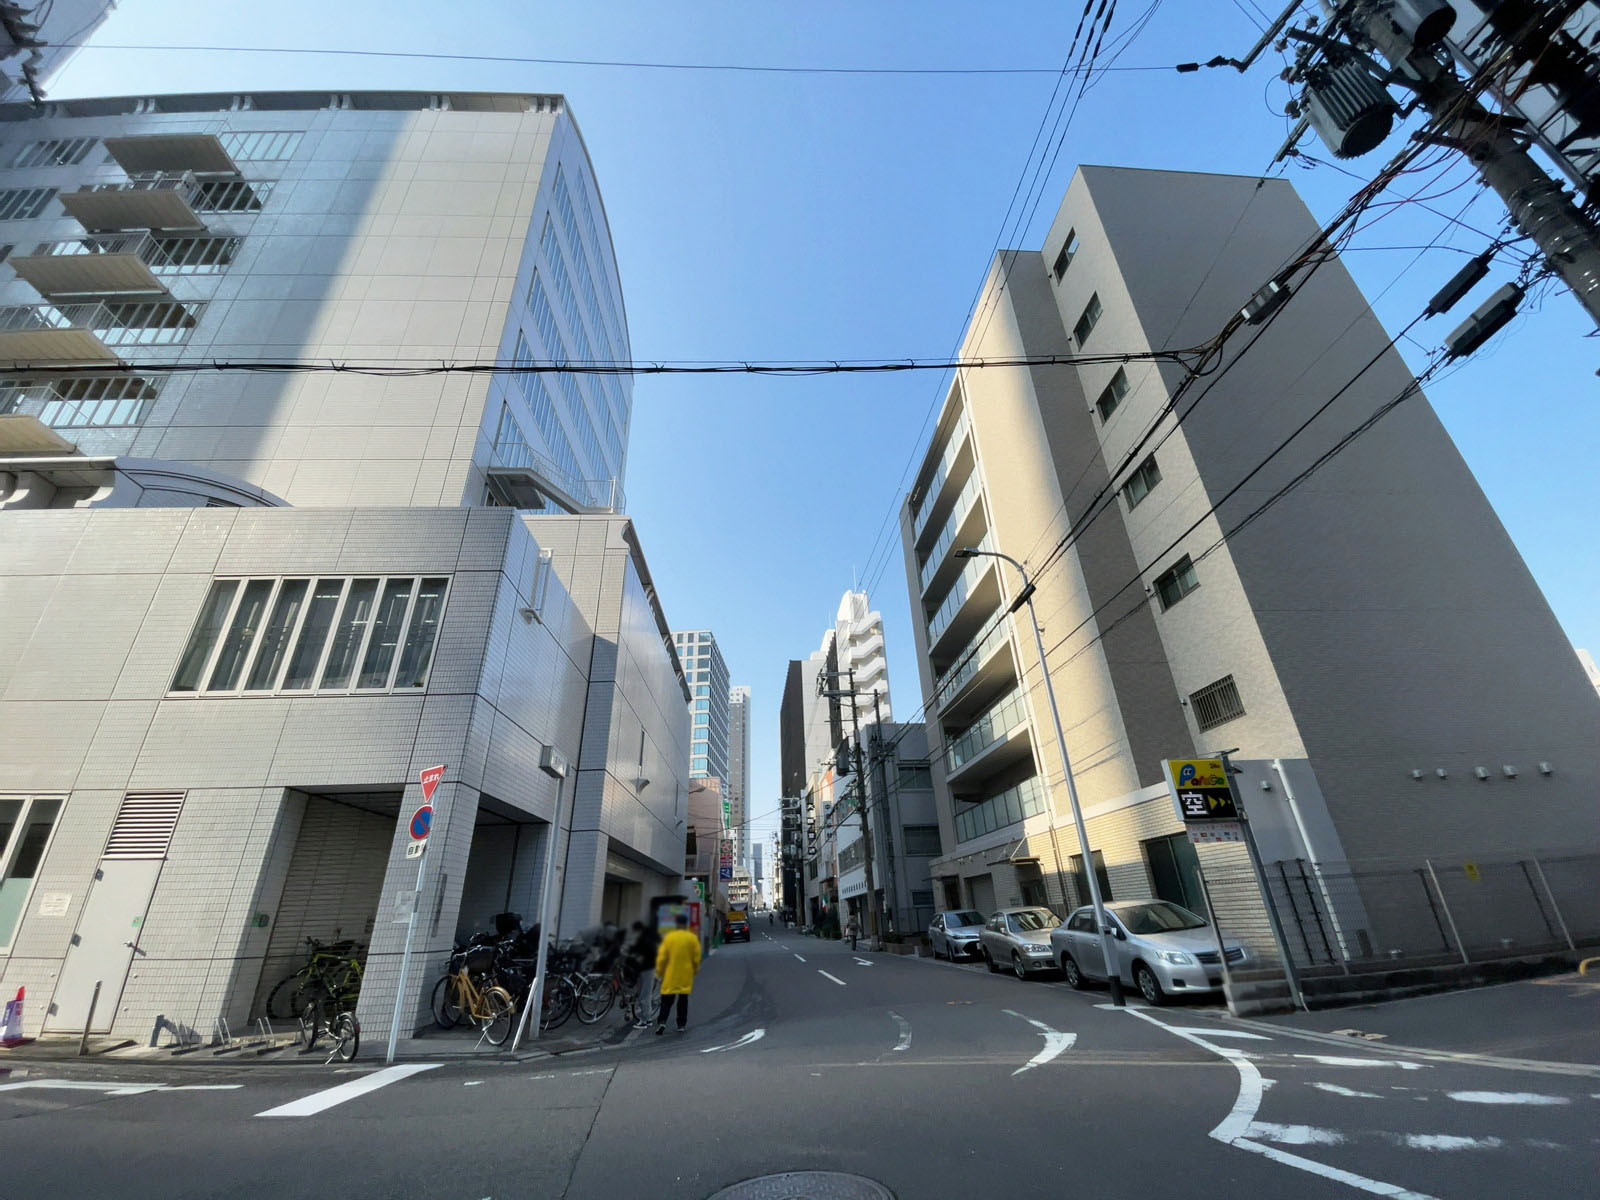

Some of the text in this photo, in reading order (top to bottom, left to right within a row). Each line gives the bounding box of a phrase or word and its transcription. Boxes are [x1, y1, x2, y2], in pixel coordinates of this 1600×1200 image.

[422, 773, 440, 784] 止まれ
[1181, 792, 1206, 814] 空
